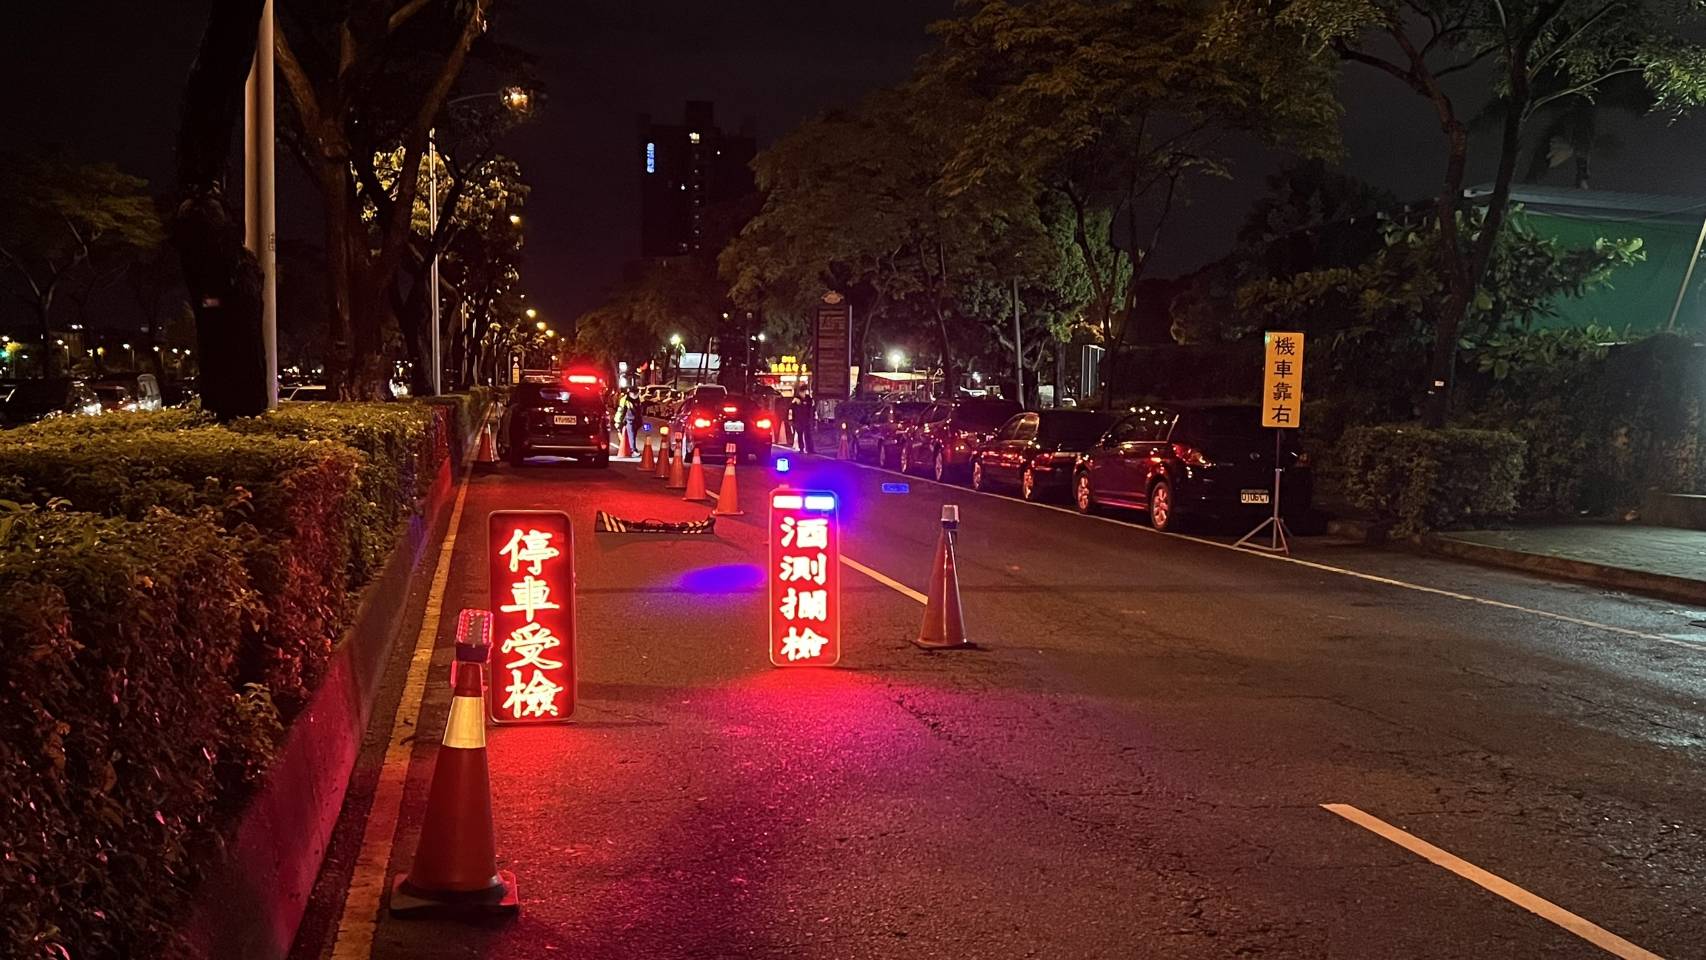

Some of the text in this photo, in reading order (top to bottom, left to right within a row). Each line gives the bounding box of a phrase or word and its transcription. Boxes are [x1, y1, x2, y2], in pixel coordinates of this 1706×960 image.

[1271, 336, 1295, 424] 機車靠右
[499, 528, 564, 719] 停車受檢
[779, 516, 829, 662] 酒測攔檢
